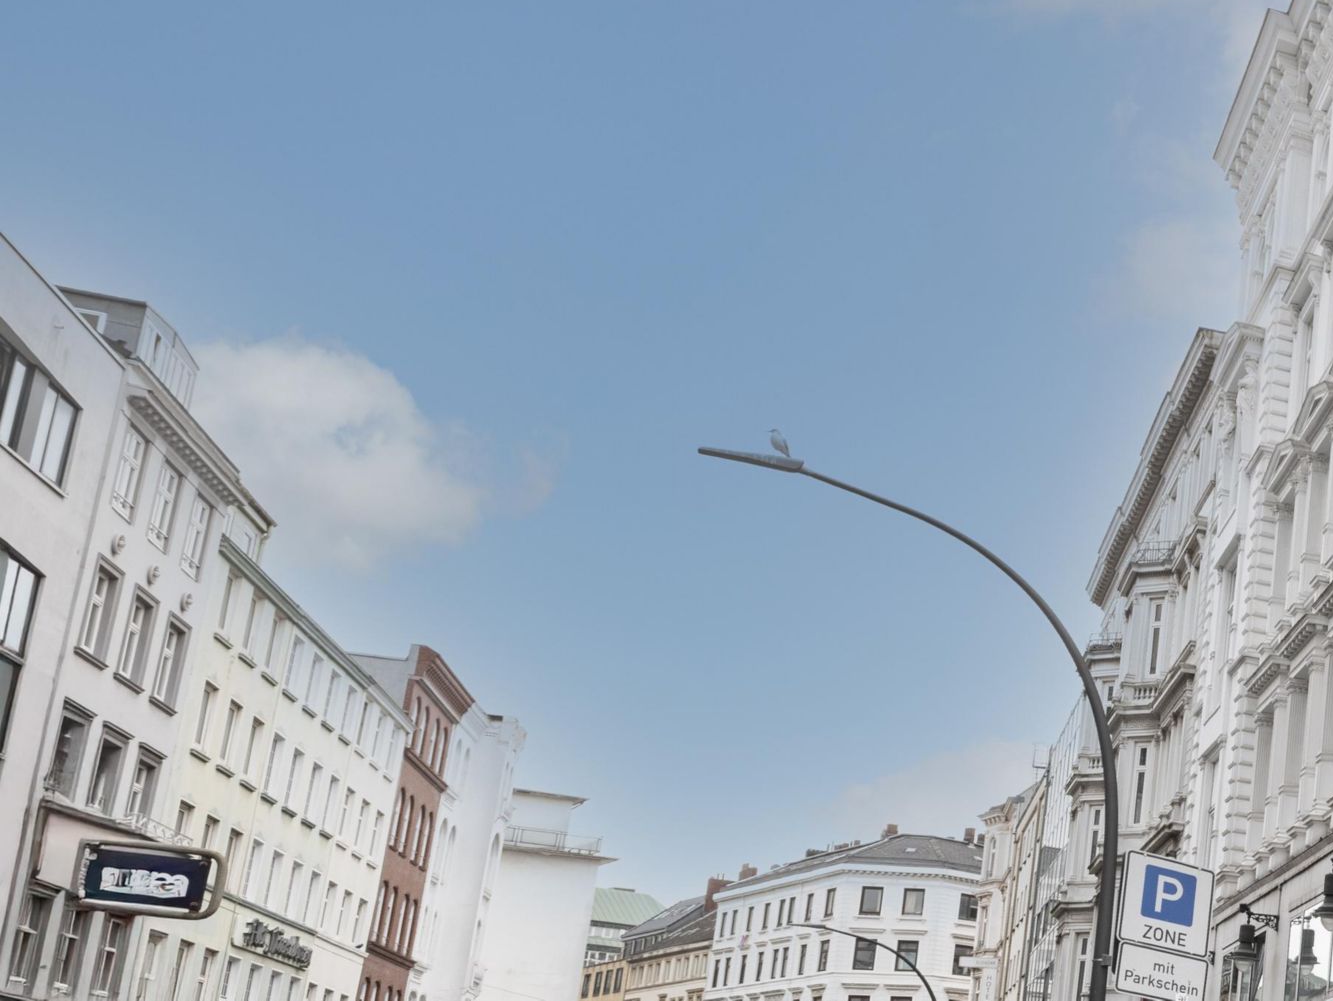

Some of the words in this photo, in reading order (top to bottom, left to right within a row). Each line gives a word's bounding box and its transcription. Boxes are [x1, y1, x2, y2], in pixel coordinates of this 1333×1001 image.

[1154, 873, 1184, 914] P
[1142, 923, 1188, 947] ZONE
[1152, 961, 1176, 976] mit
[1123, 968, 1199, 996] Parkschein
